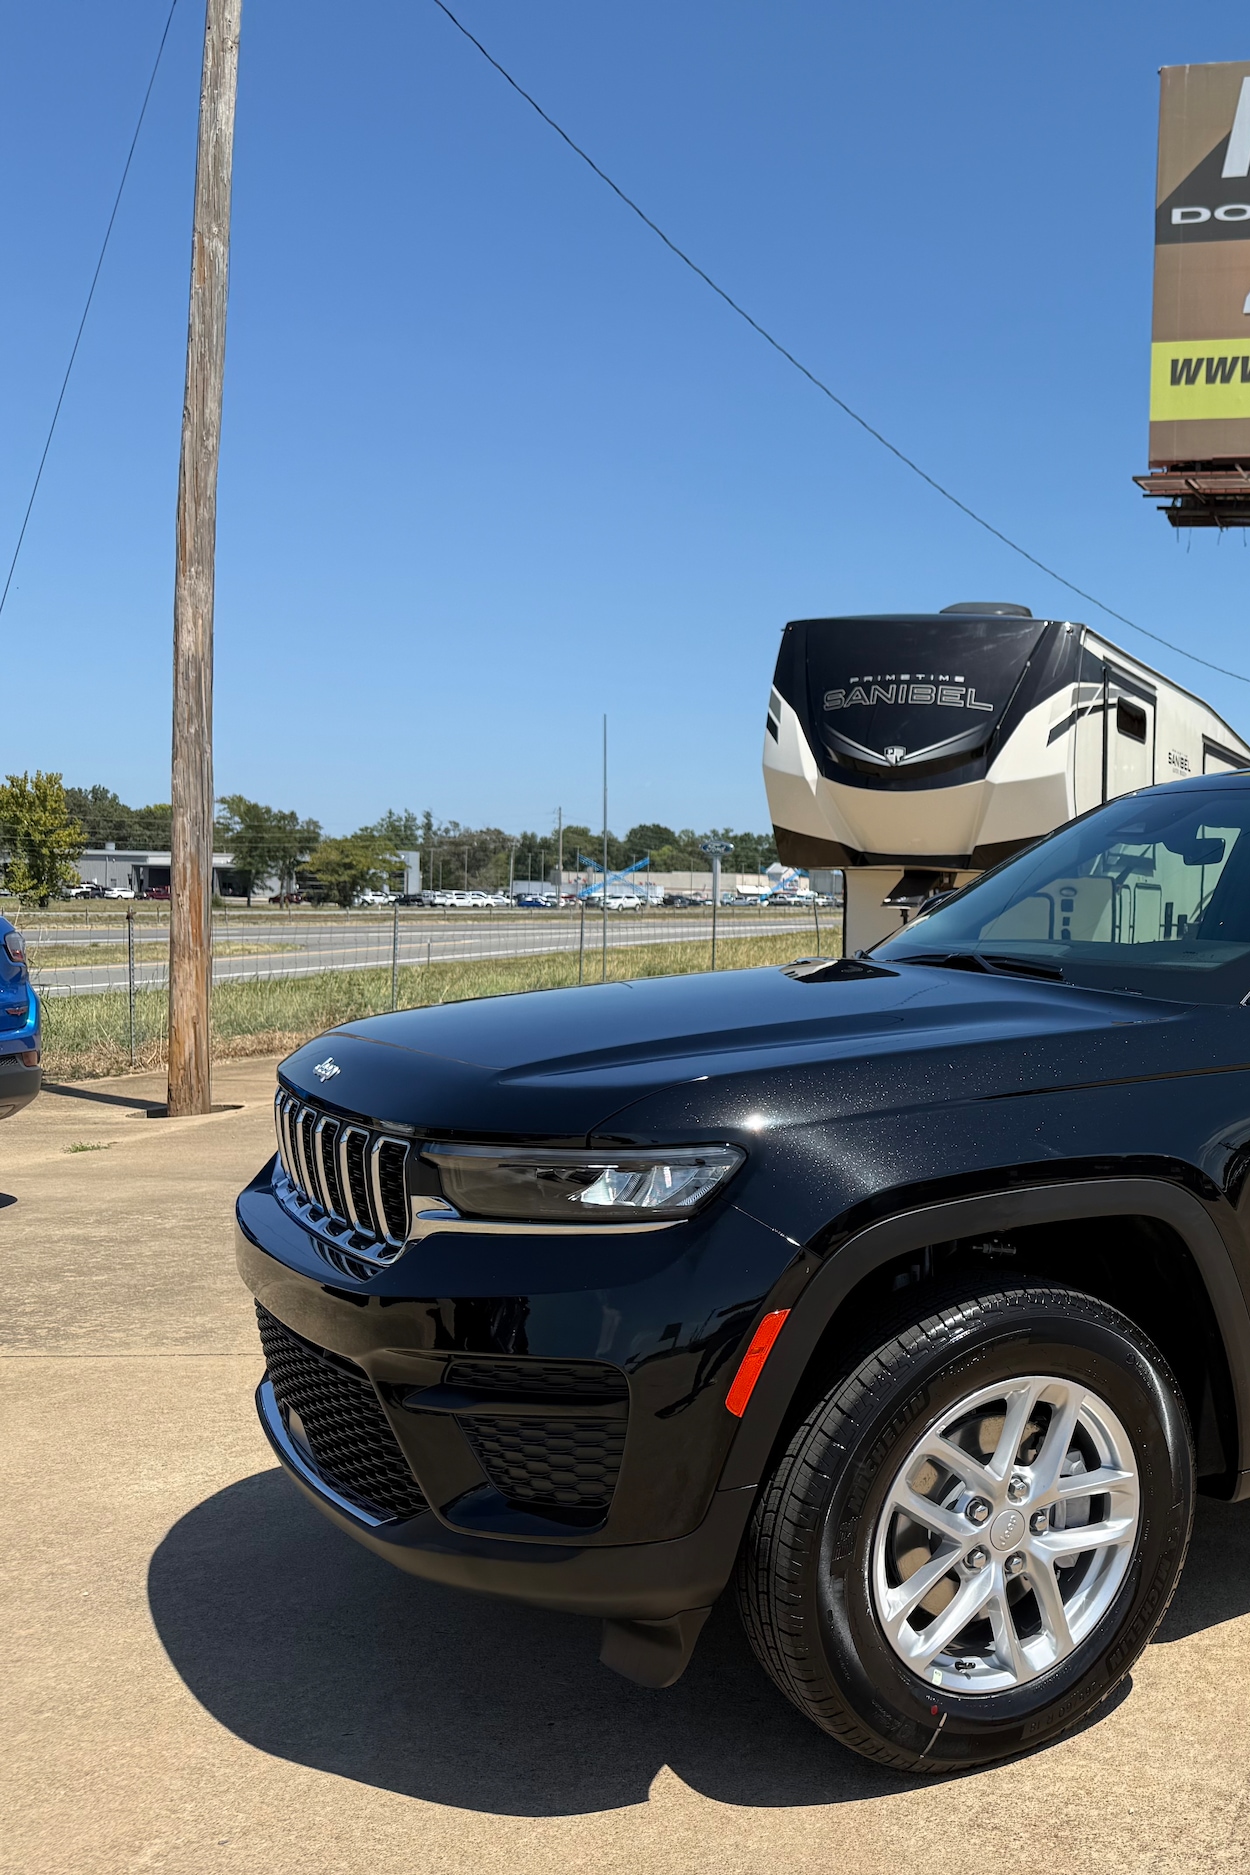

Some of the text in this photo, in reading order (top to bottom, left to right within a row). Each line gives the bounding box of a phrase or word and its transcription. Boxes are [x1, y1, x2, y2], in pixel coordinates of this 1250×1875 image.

[823, 684, 993, 712] SANIBEL
[1168, 752, 1191, 772] SANIBEL
[849, 1390, 928, 1513] MICHELIN
[1000, 1514, 1016, 1546] Jeep
[1108, 1557, 1171, 1671] MICHELIN
